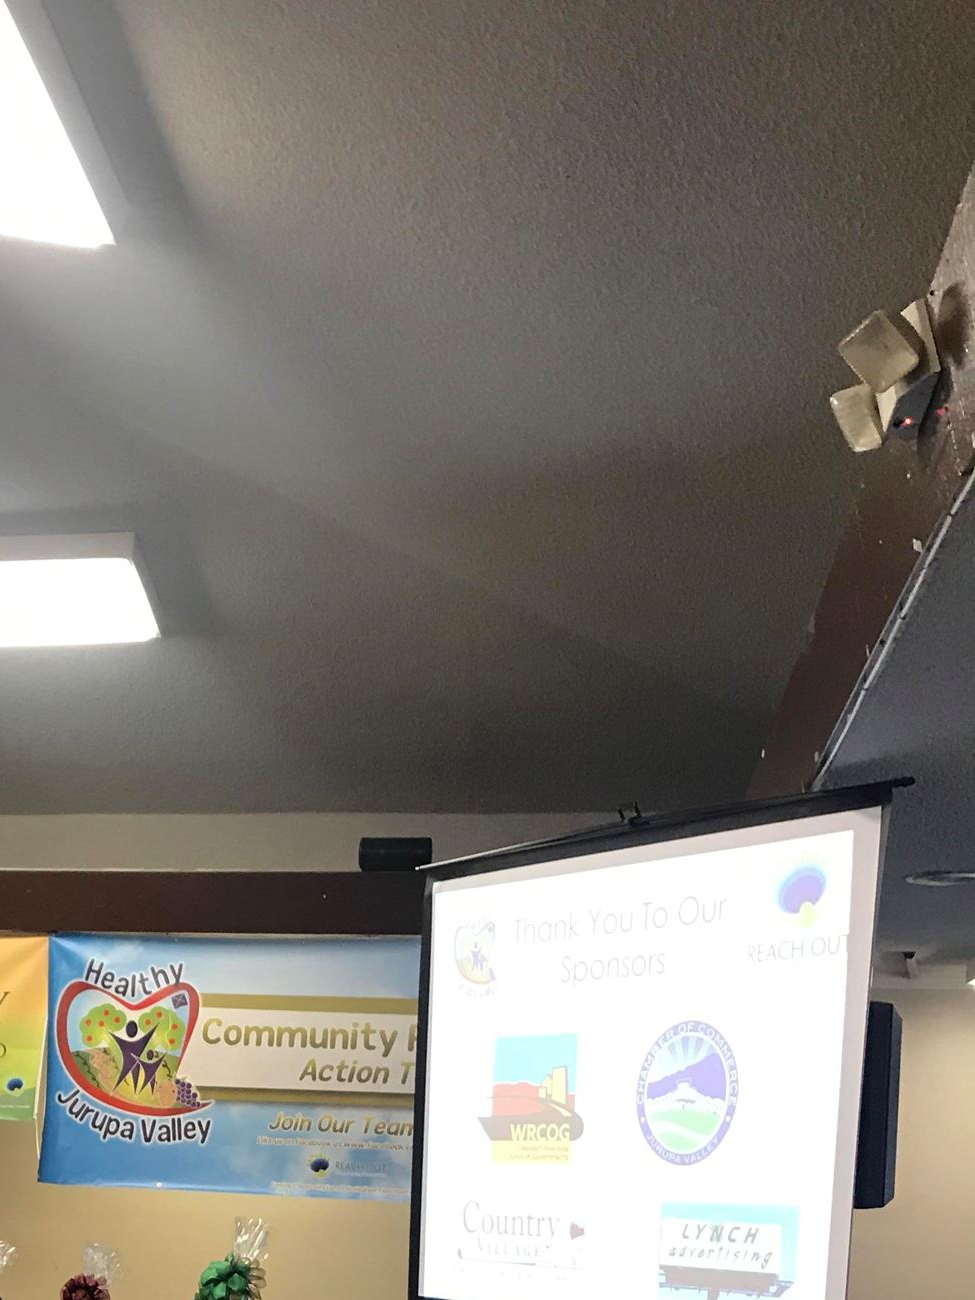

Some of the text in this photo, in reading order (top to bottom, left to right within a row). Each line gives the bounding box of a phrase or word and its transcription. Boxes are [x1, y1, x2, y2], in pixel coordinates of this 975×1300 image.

[514, 911, 578, 944] Thank
[588, 909, 634, 935] You
[642, 902, 668, 929] To
[678, 896, 727, 925] Our
[748, 934, 849, 962] REACH OUT
[84, 958, 183, 998] Healthy
[561, 953, 665, 988] Sponsors
[202, 1018, 398, 1057] Community
[299, 1058, 389, 1085] Action
[636, 1021, 738, 1106] CHAMBER OF COMMERCE
[57, 1089, 211, 1144] Jurupa Valley
[268, 1112, 312, 1132] Join
[318, 1114, 354, 1134] Our
[511, 1124, 570, 1141] WRCOG
[647, 1134, 719, 1163] JURUPA VALLEY
[463, 1200, 561, 1237] Country
[477, 1237, 543, 1257] VILLAGE
[682, 1223, 759, 1244] LYNCH
[669, 1246, 773, 1269] advertising
